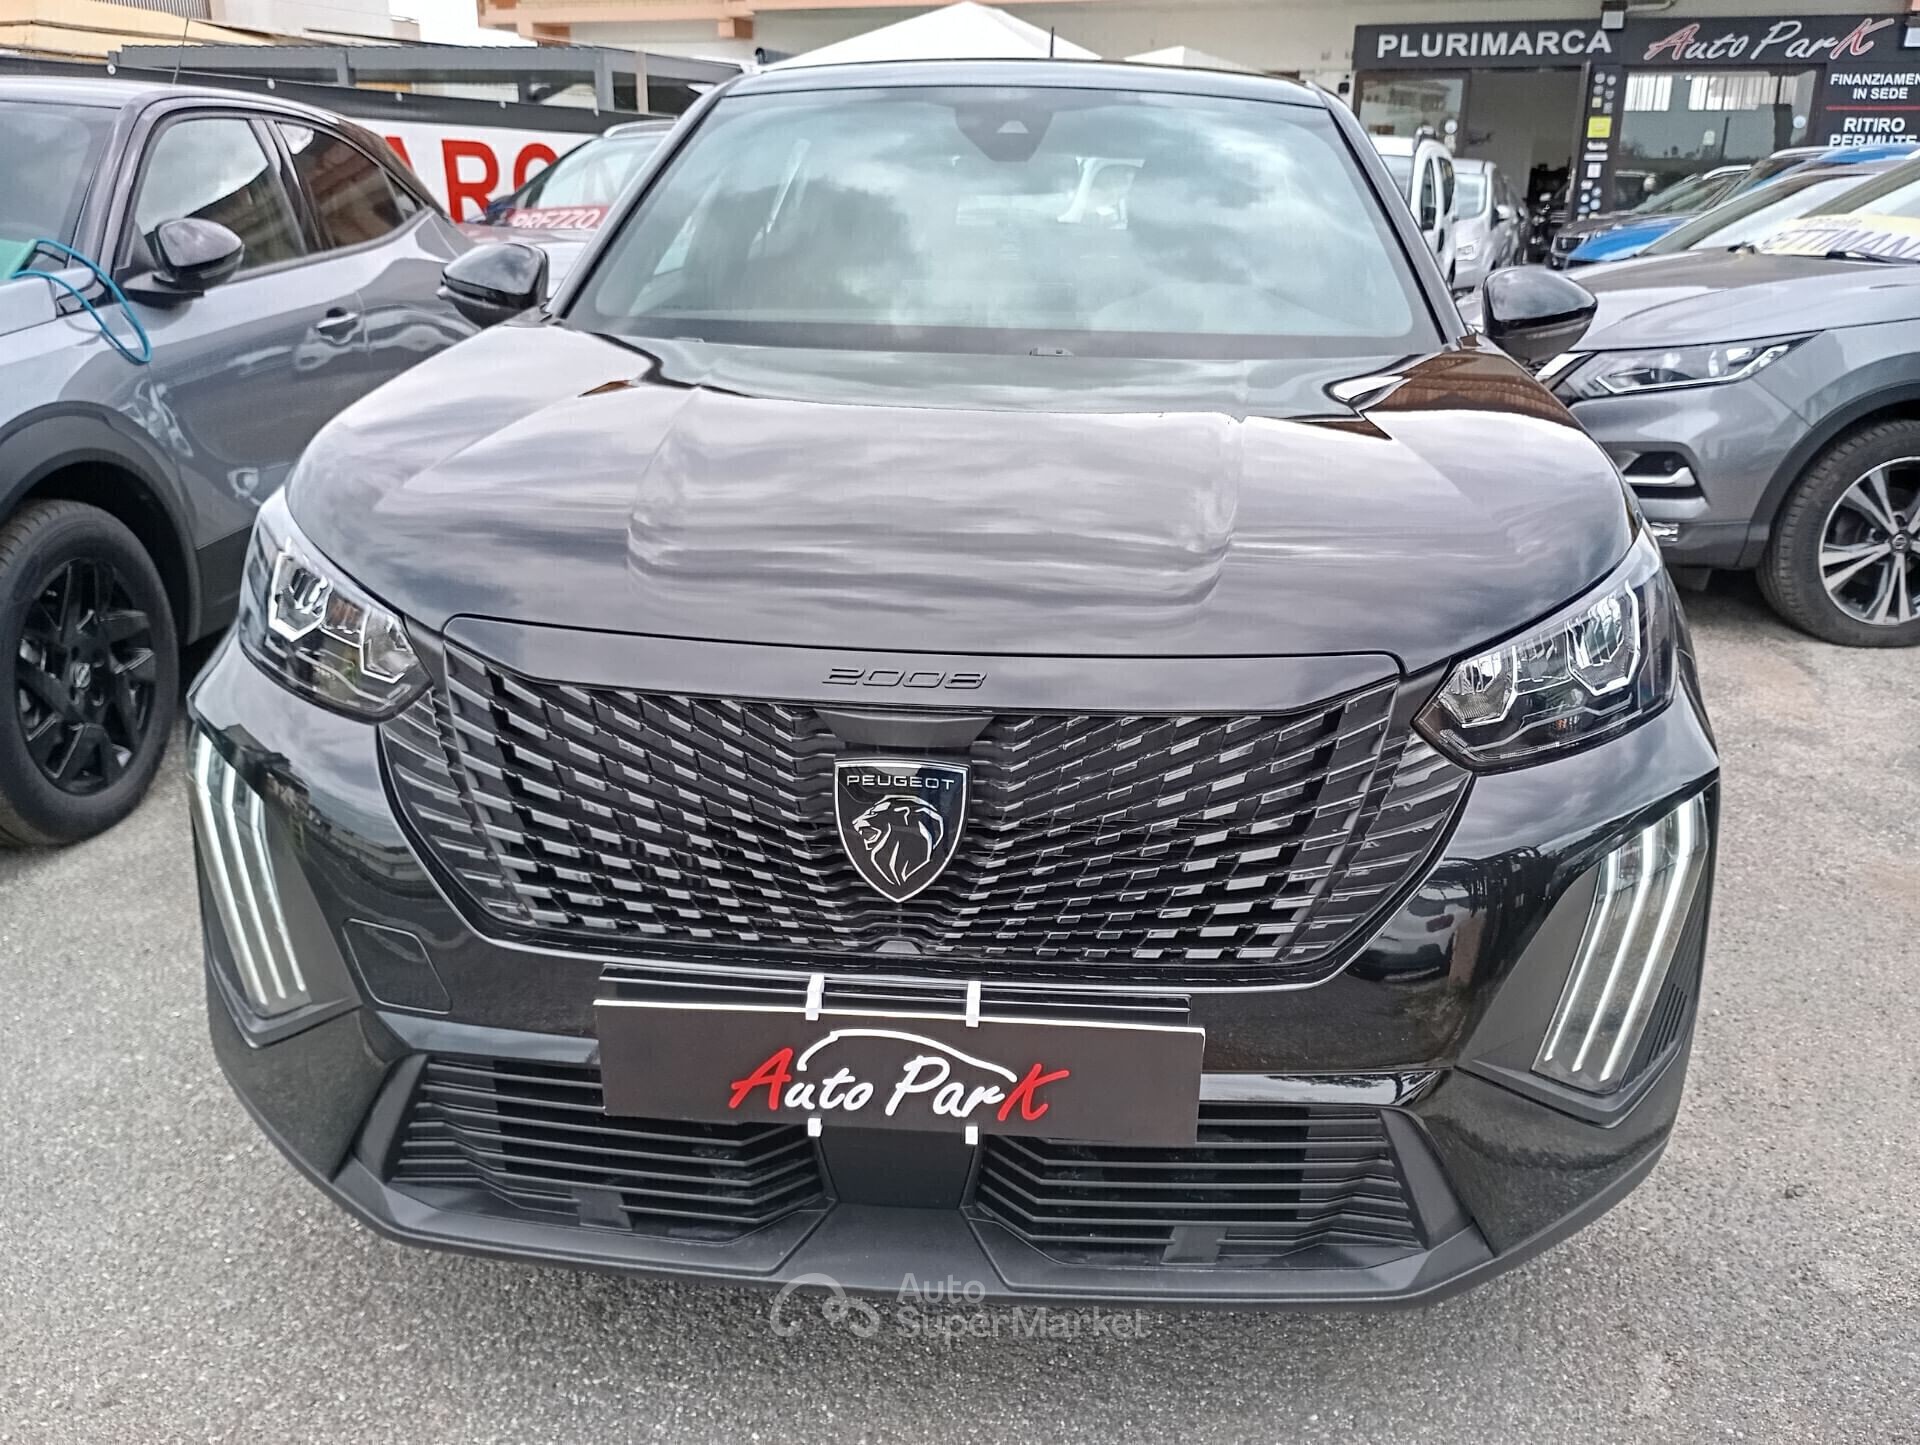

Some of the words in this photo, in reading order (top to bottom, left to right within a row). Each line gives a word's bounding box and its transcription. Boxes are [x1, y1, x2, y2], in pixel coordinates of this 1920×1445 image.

[1376, 29, 1612, 59] PLURIMARCA
[1643, 23, 1748, 62] Auto
[1852, 87, 1868, 100] IN
[1870, 87, 1909, 100] SEDE
[1843, 117, 1906, 133] RITIRO
[822, 668, 987, 690] 2008
[846, 775, 955, 791] PEUGEOT
[728, 1047, 875, 1112] Auto
